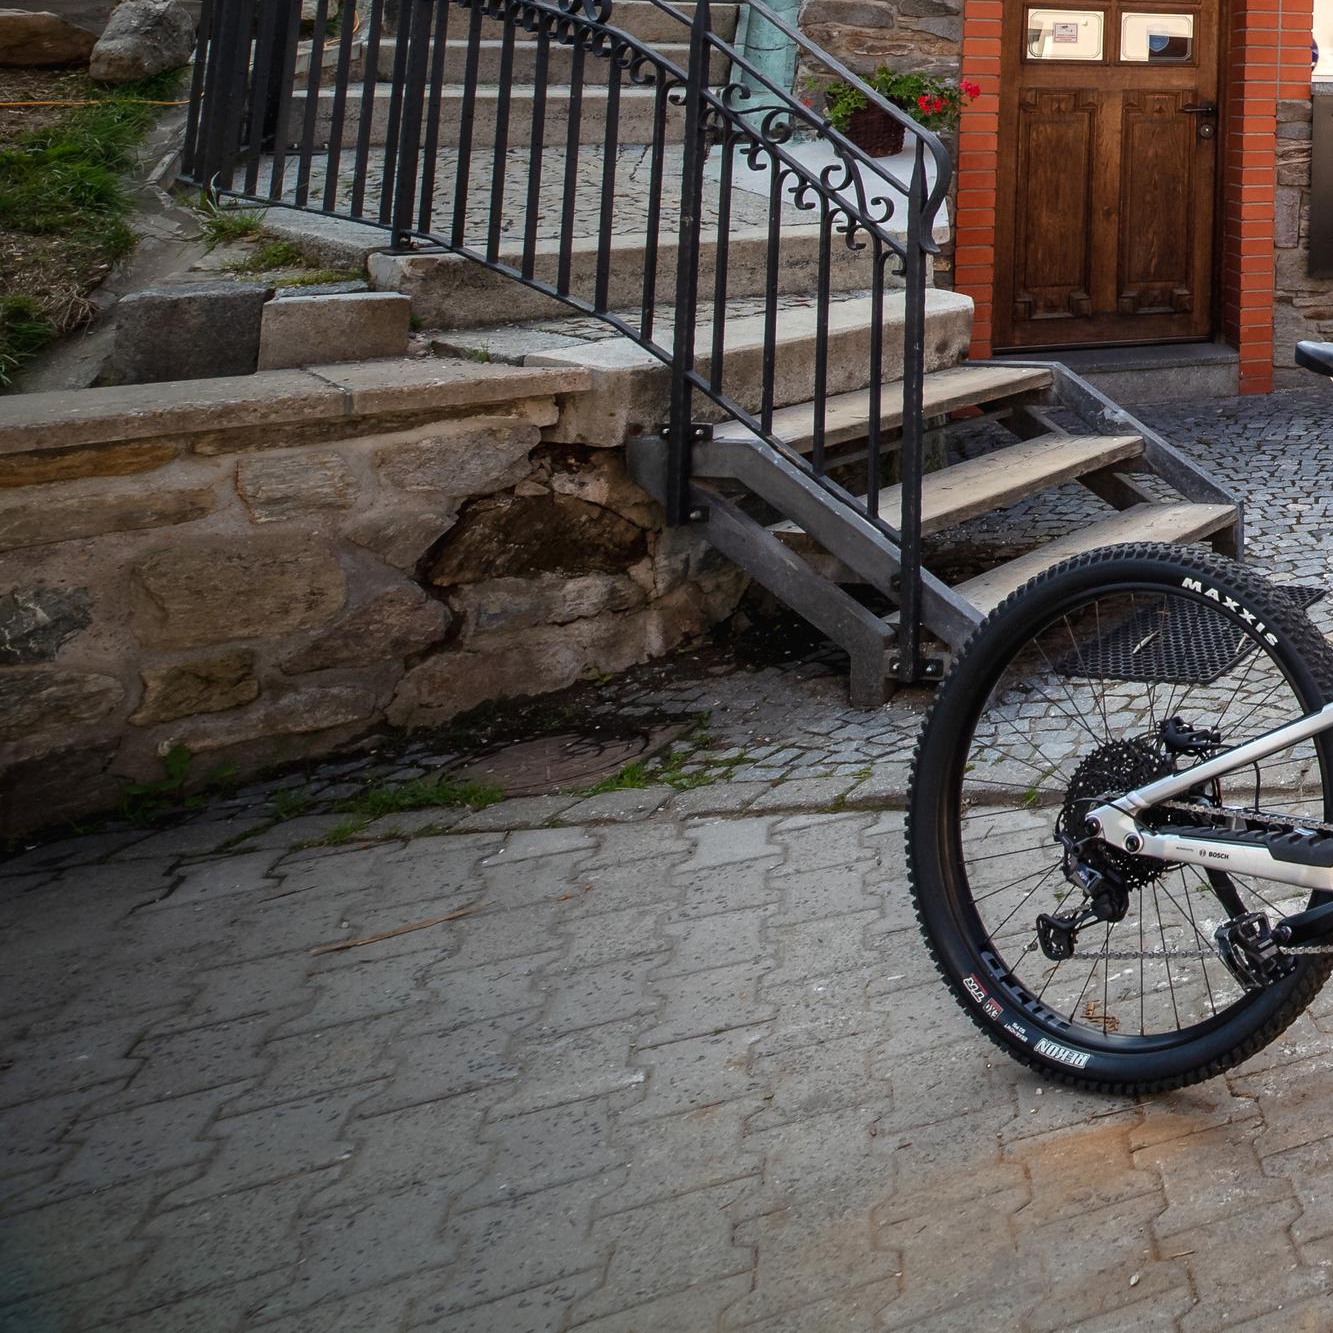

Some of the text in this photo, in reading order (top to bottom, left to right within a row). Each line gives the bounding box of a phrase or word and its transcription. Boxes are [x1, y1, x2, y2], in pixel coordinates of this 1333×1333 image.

[1181, 577, 1279, 646] MAXXIS
[1208, 851, 1230, 860] BOSCH
[1033, 1037, 1091, 1069] REKON
